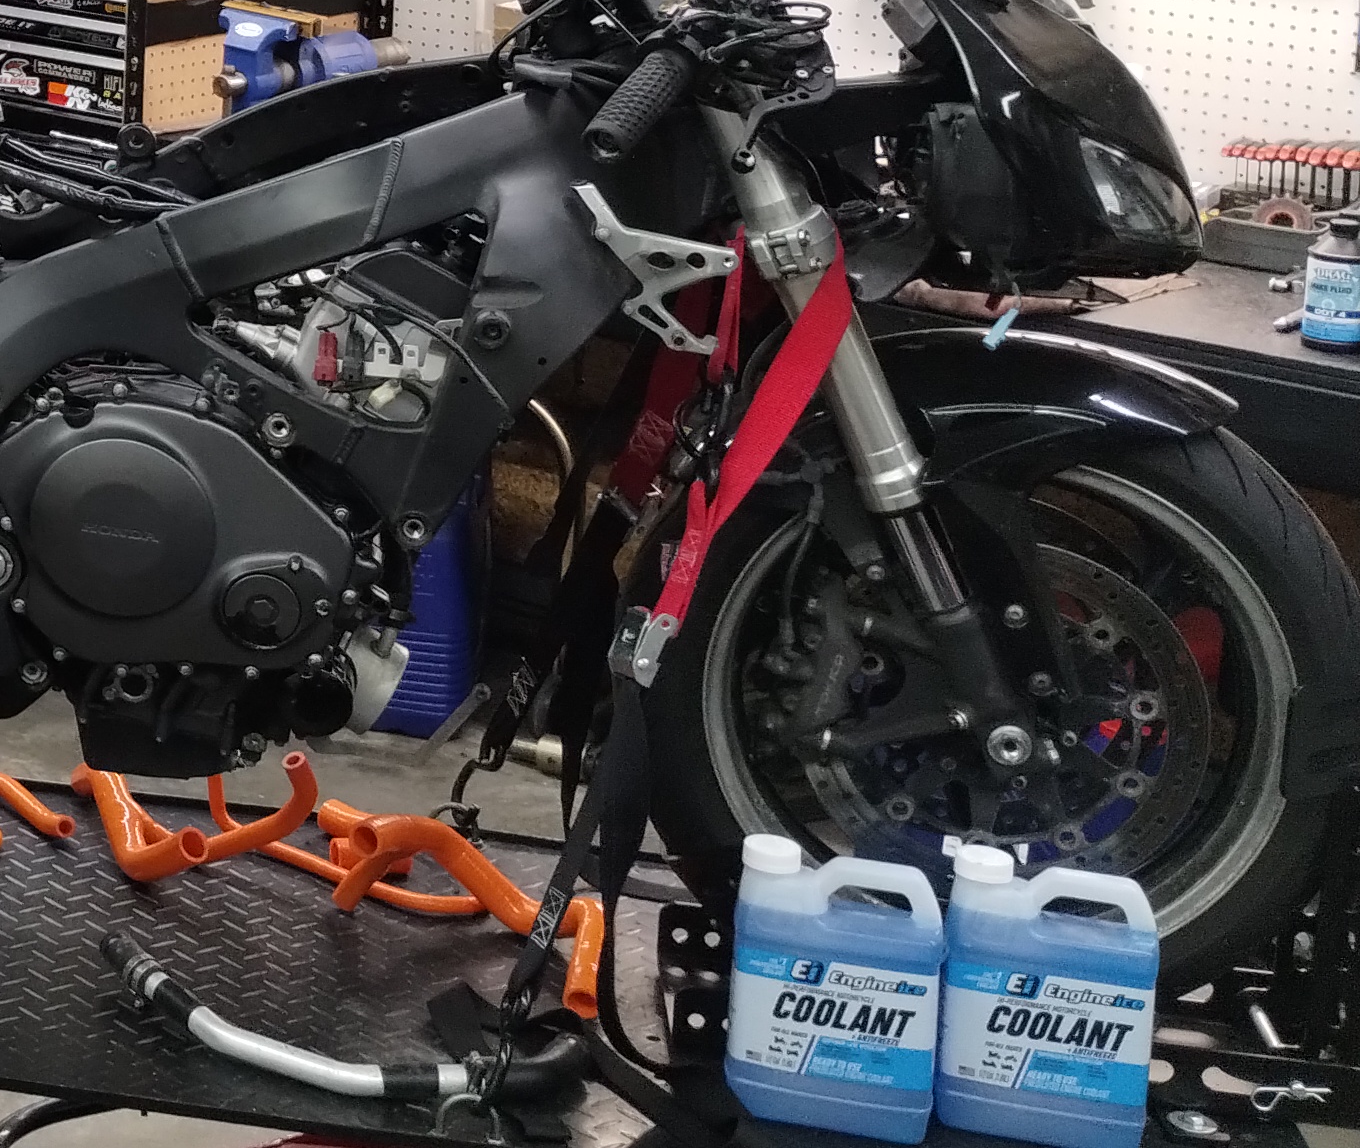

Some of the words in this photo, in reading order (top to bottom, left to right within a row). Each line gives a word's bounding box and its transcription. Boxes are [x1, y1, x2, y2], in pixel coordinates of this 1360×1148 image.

[80, 521, 160, 544] HONDA
[773, 990, 916, 1038] COOLANT
[986, 1004, 1135, 1052] COOLANT
